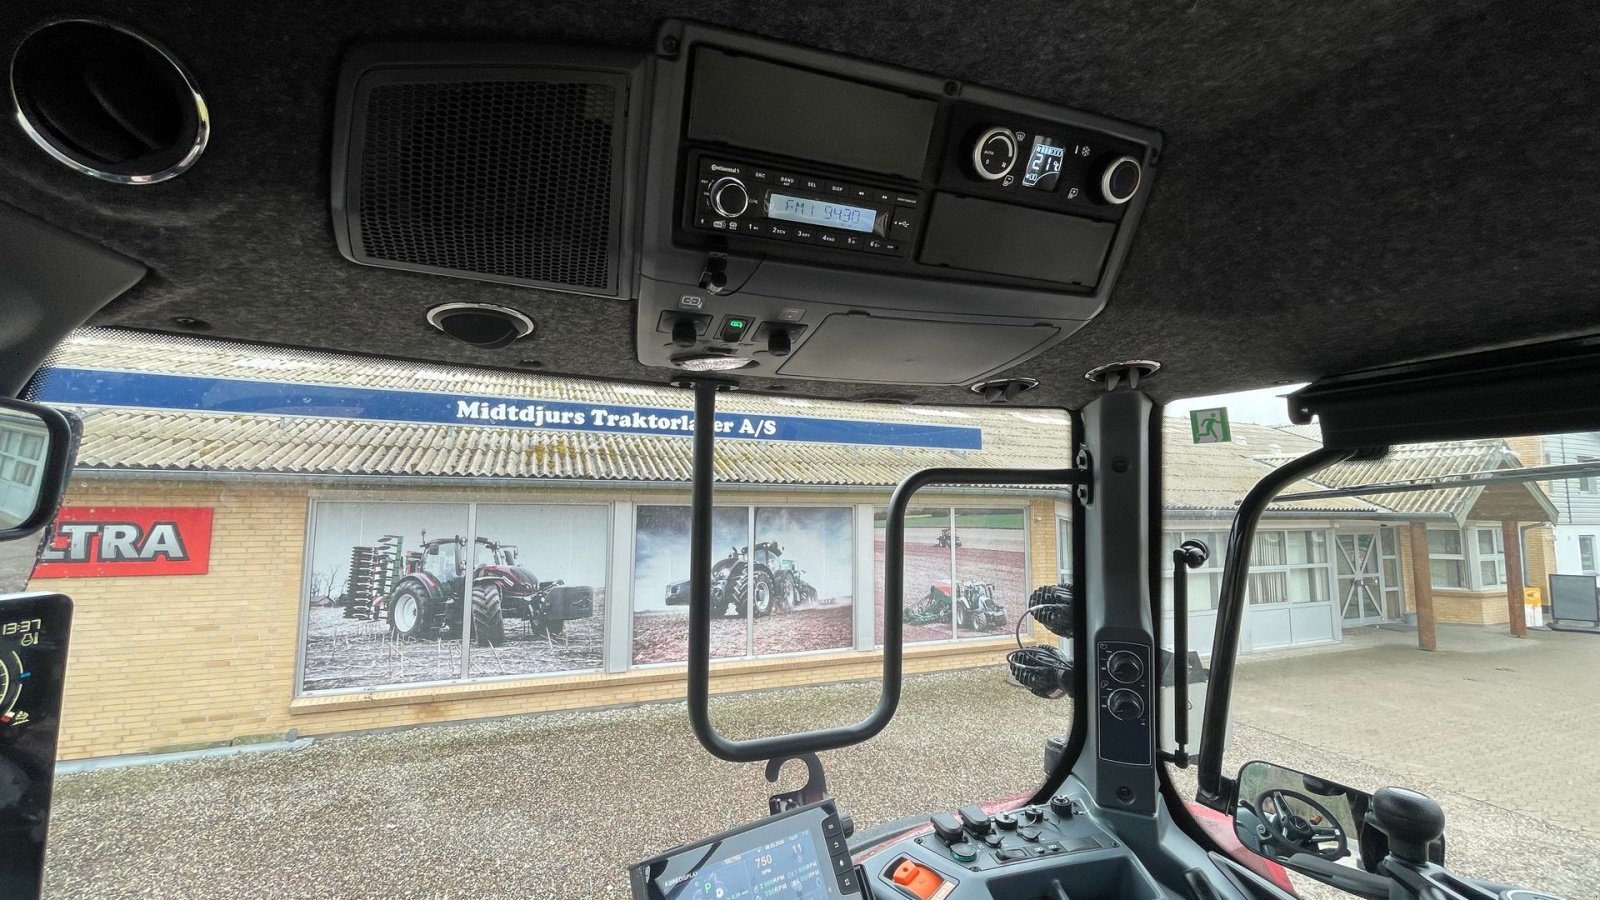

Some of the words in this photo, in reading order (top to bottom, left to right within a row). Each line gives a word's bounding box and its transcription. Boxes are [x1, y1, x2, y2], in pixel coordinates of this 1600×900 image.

[456, 400, 585, 426] Midtdjurs
[591, 409, 735, 434] Traktorler
[739, 418, 777, 438] A/S
[2, 618, 41, 635] 13:37
[755, 854, 773, 869] 750
